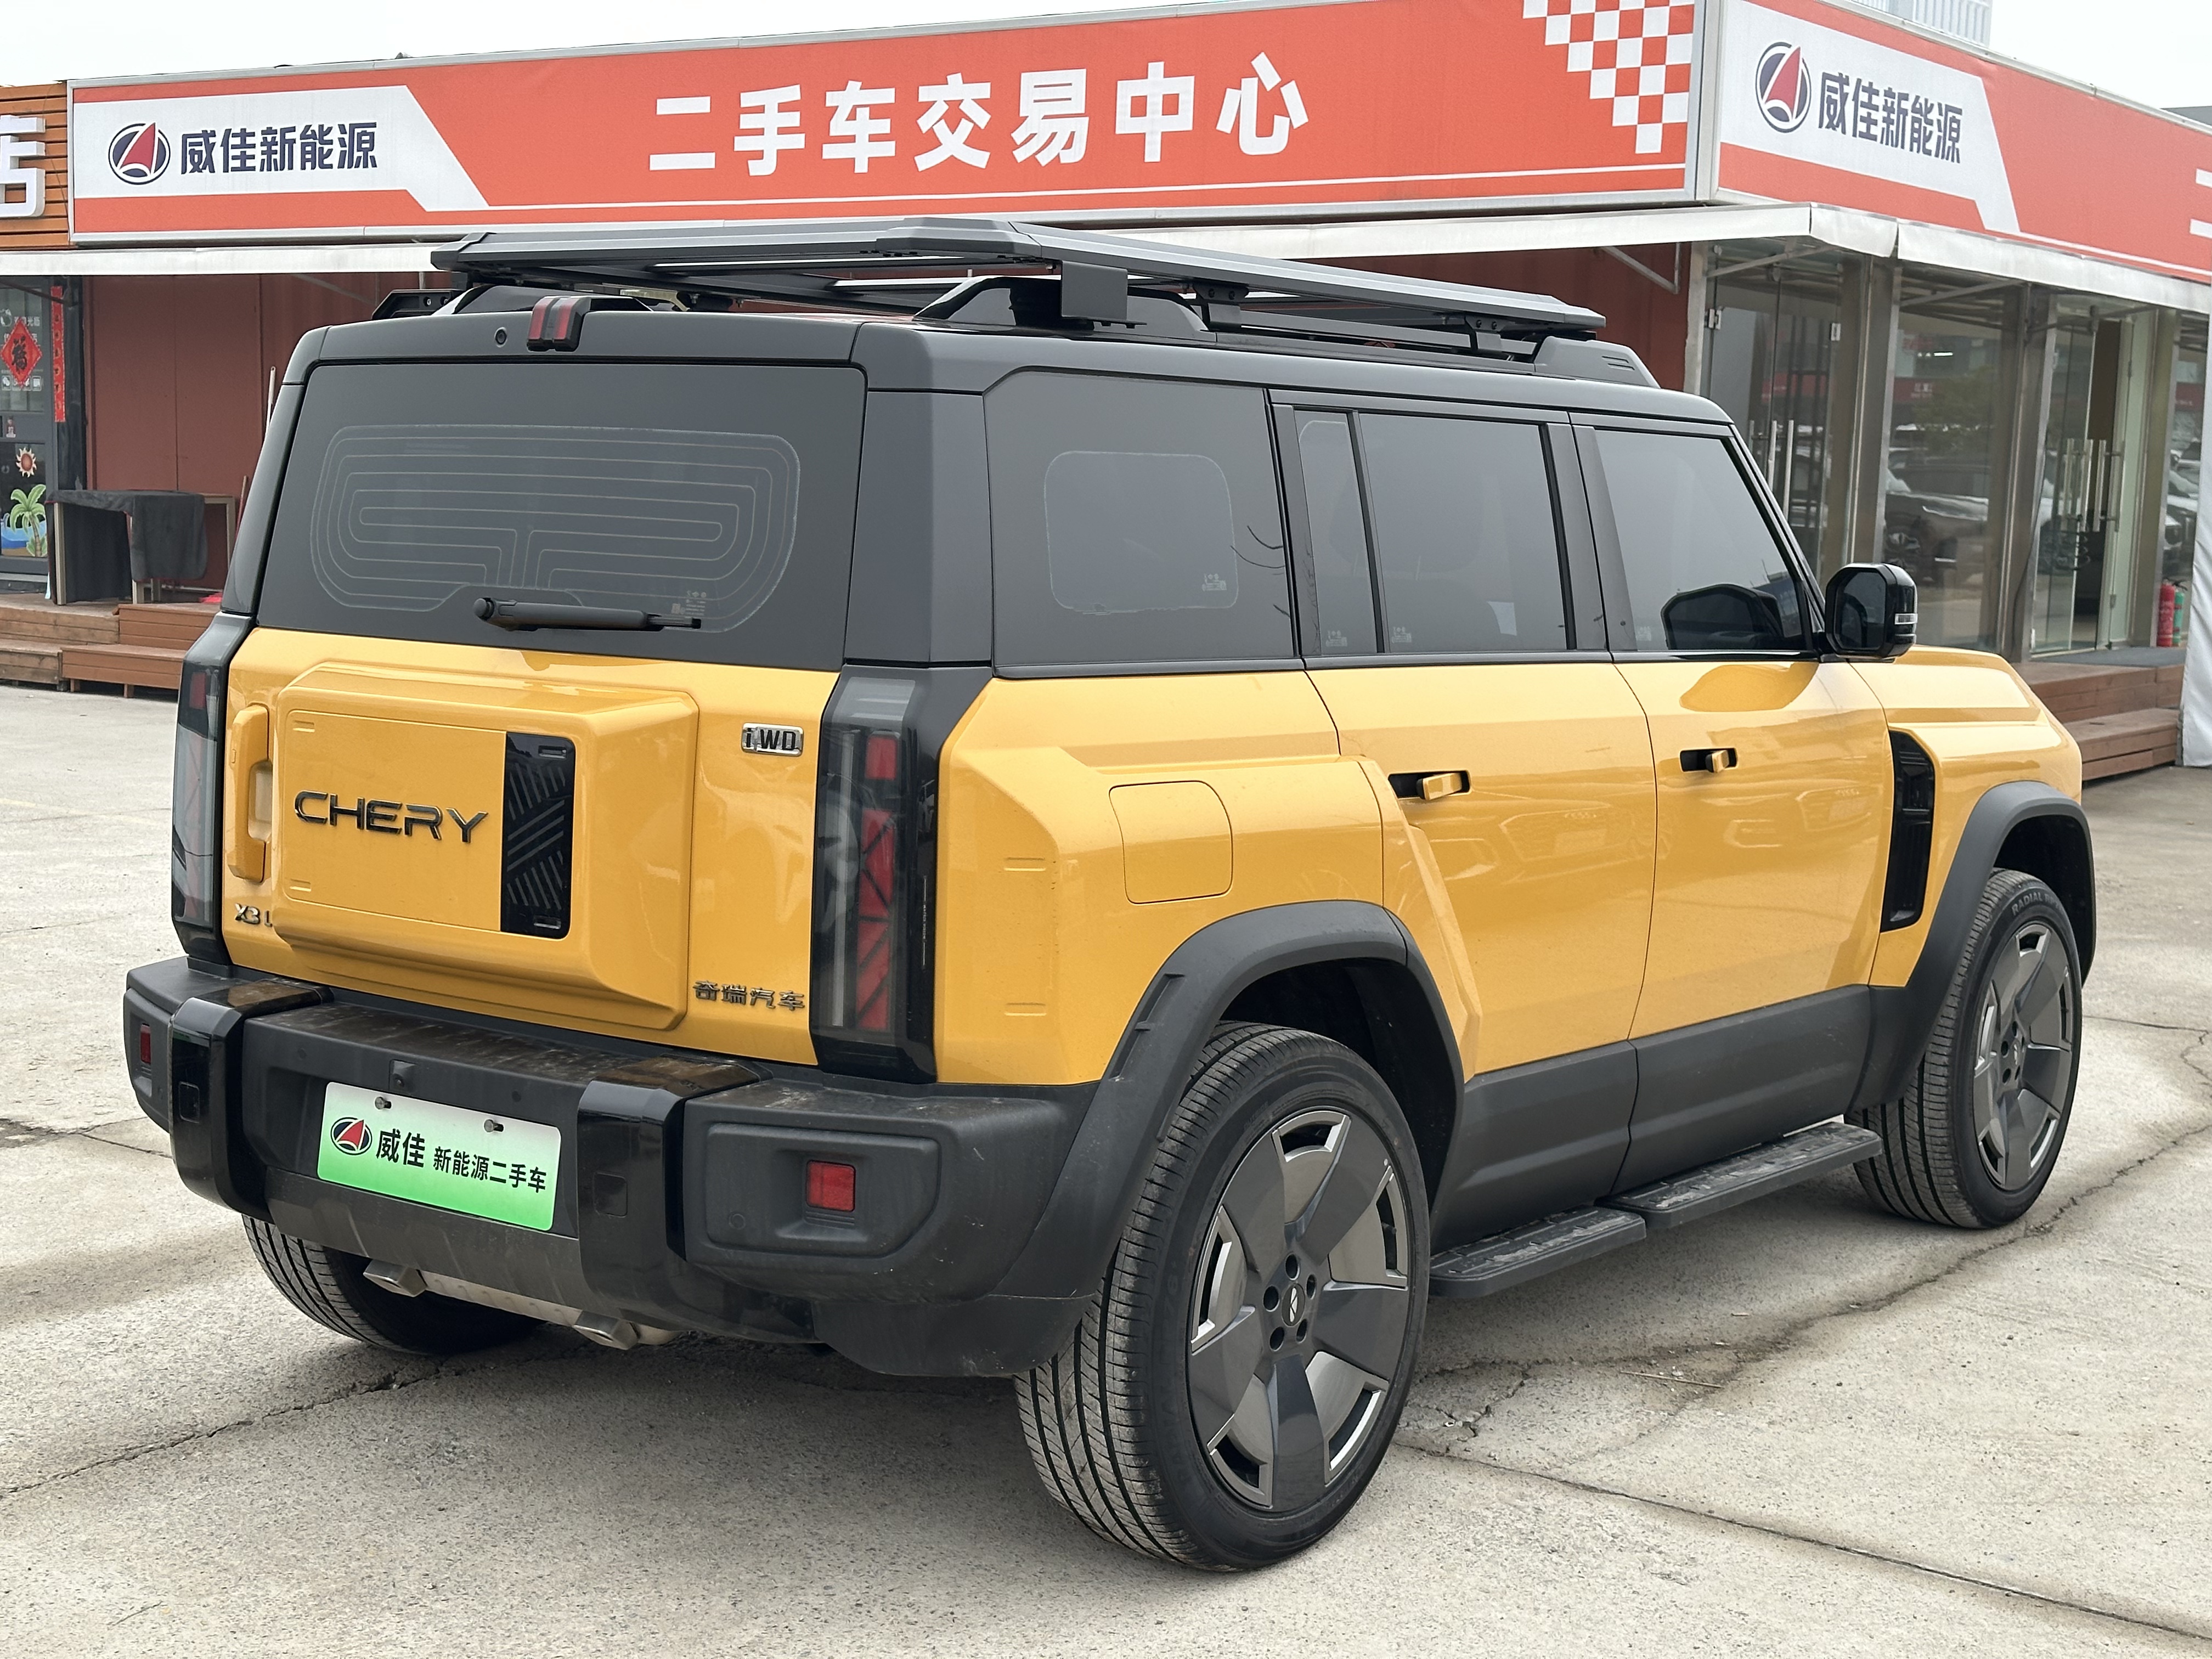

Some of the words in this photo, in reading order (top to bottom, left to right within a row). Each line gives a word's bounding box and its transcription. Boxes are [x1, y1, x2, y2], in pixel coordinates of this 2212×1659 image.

[649, 52, 1308, 177] 二手车交易中心
[1818, 72, 1963, 164] 威佳新能源
[180, 122, 377, 174] 威佳新能源
[294, 790, 488, 843] CHERY
[2011, 891, 2043, 916] RADIAL
[692, 980, 805, 1011] 奇瑞汽车
[375, 1128, 425, 1168] 威佳
[433, 1146, 546, 1193] 新能源二手车
